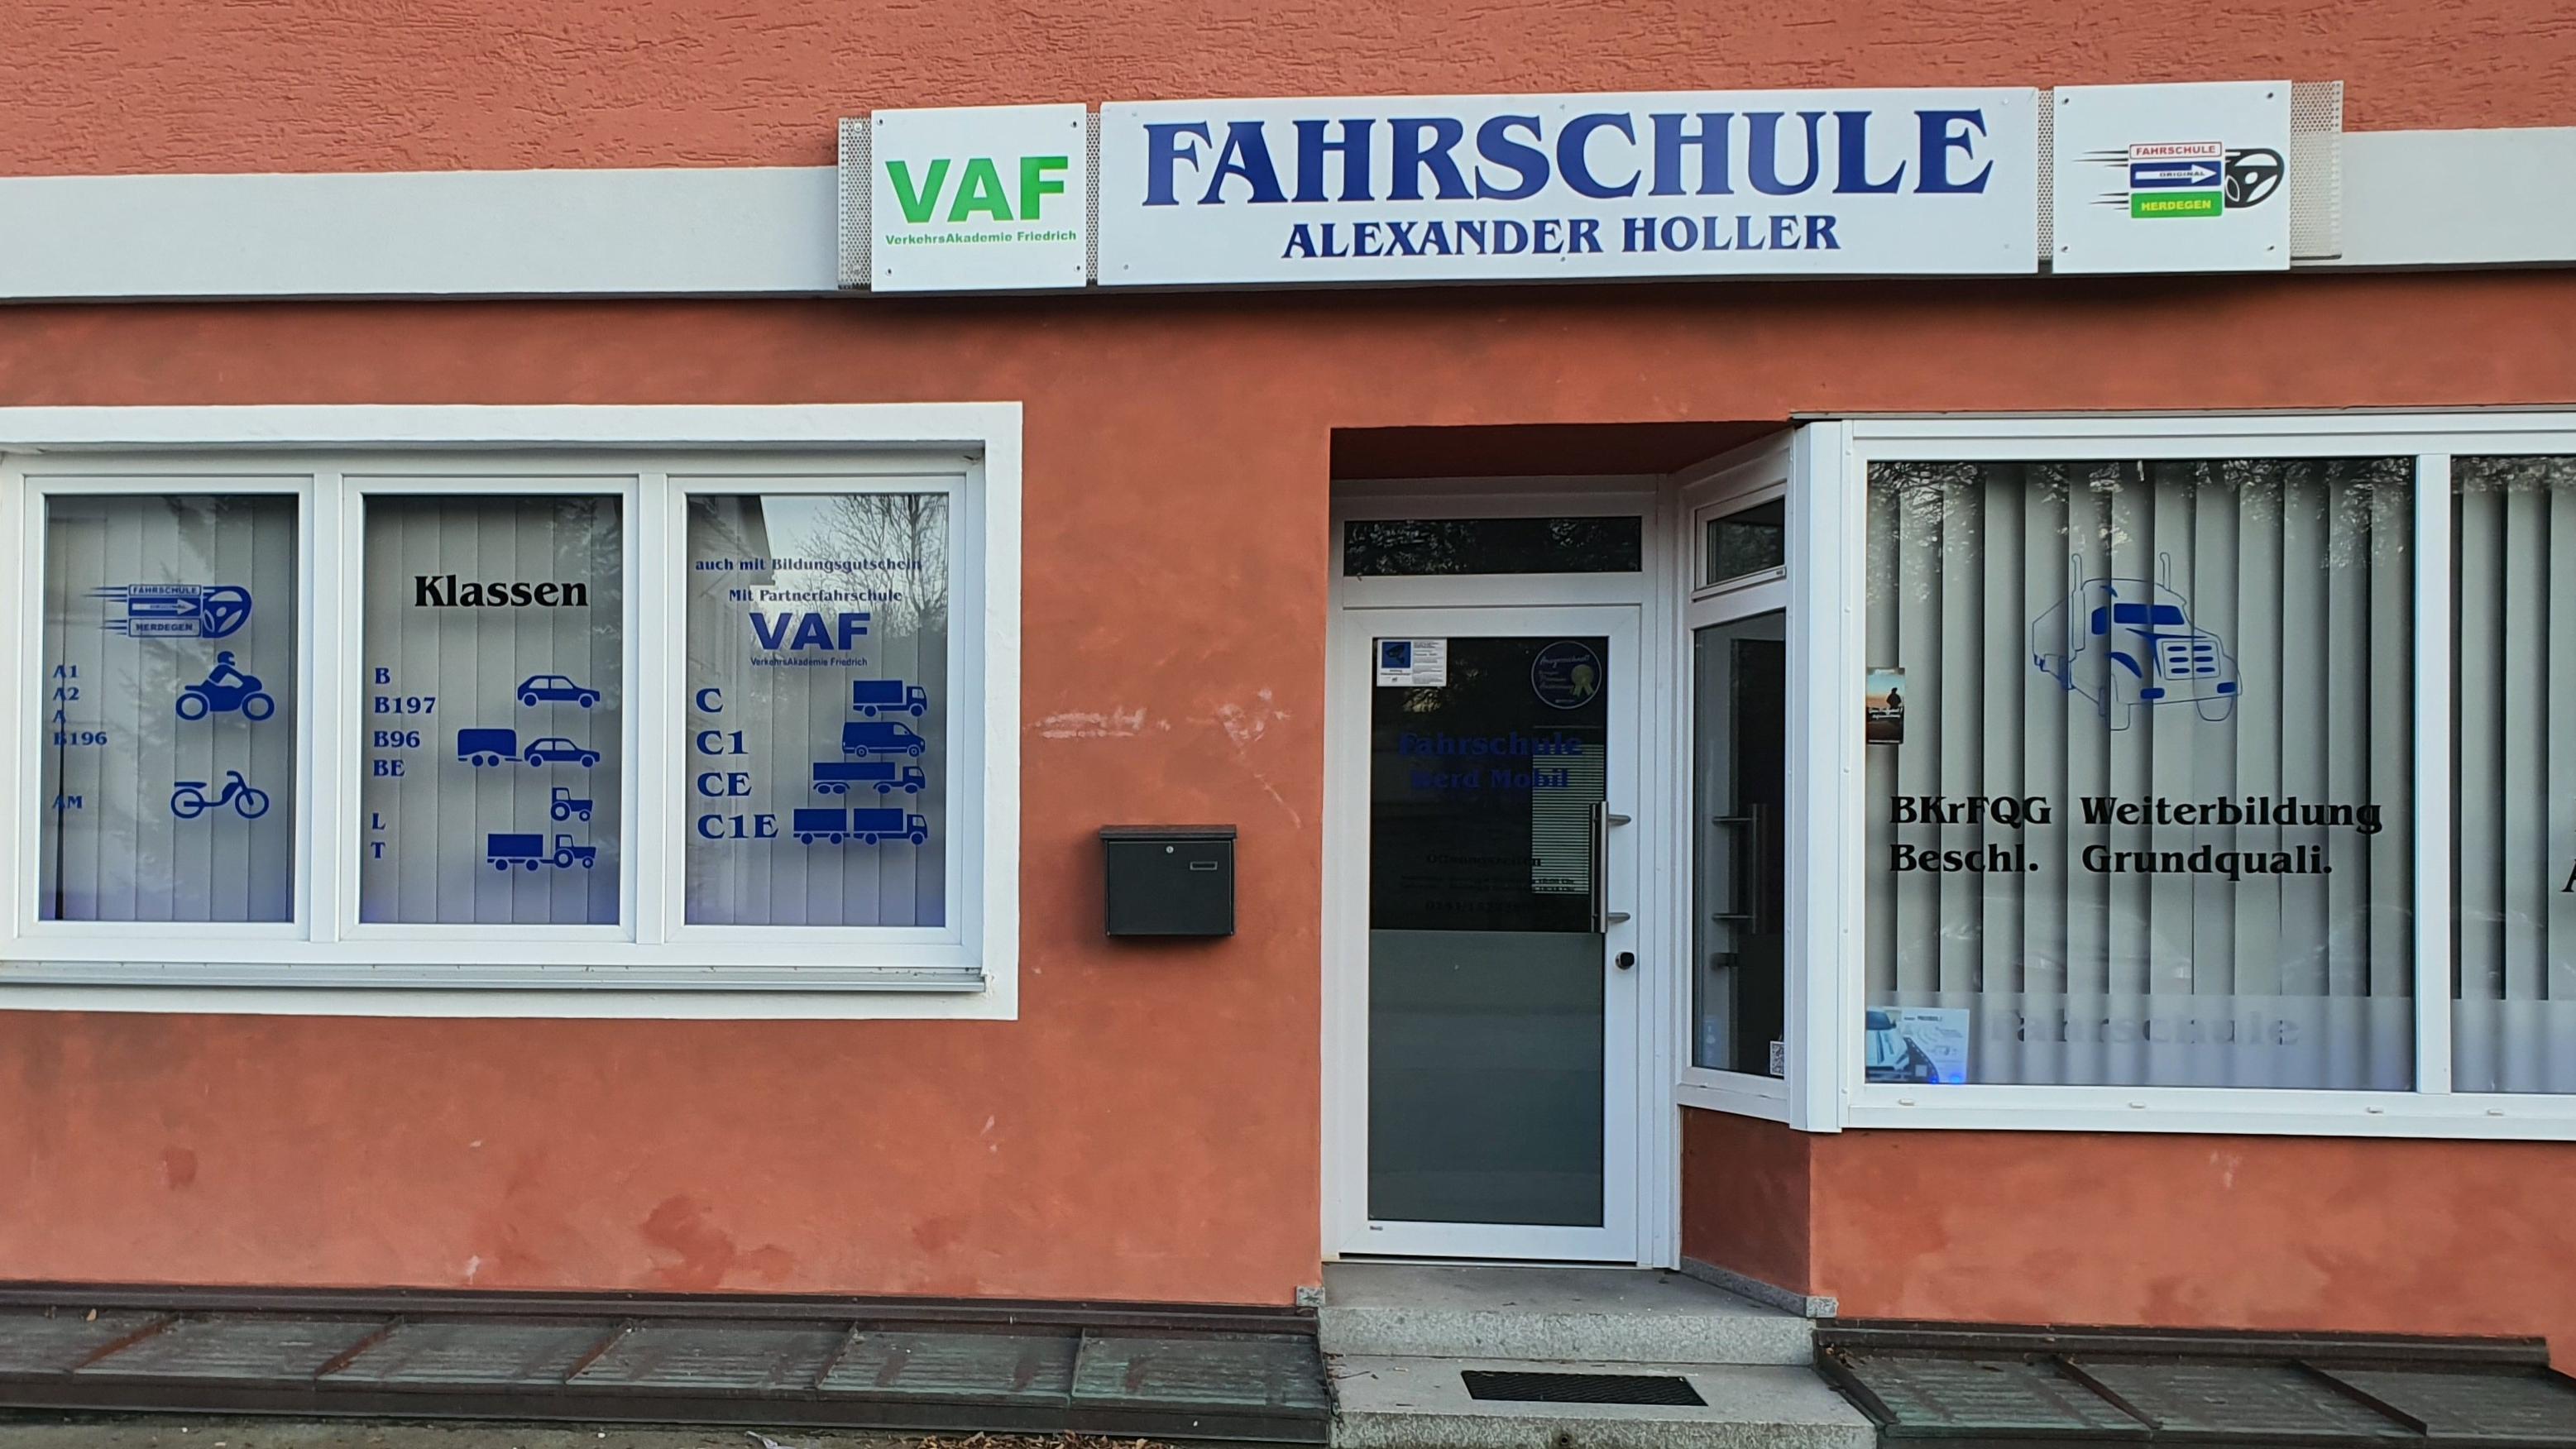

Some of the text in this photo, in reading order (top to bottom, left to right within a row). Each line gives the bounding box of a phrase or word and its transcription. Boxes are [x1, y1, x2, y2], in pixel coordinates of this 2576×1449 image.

[1142, 108, 1994, 207] FAHRSCHULE
[2136, 144, 2216, 156] FAHRSCHULE
[885, 155, 1070, 223] VAF
[2141, 199, 2211, 212] HERDEGEN
[885, 229, 1078, 246] VerkehrsAkademie Friedrich
[1281, 213, 1841, 260] ALEXANDER HOLLER
[695, 557, 922, 574] auch mit Bildungsgutschein
[133, 586, 198, 596] FAHRSCHULE
[414, 574, 589, 608] Klassen
[729, 588, 903, 602] Mit Partnerfahrschule
[136, 623, 194, 631] HERDEGEN
[749, 612, 871, 650] VAF
[750, 657, 869, 667] VerkehrsAkademie Friedrich
[52, 665, 79, 679] A1
[374, 667, 391, 685] B
[52, 687, 80, 702] A2
[695, 687, 724, 714] C
[374, 696, 437, 715] B197
[52, 709, 67, 724] A
[52, 731, 108, 747] B196
[373, 729, 422, 749] B96
[696, 729, 749, 756] C1
[1399, 730, 1583, 755] Fahrschule
[372, 759, 405, 777] BE
[697, 772, 753, 797] CE
[52, 794, 83, 810] AM
[371, 812, 386, 830] L
[1889, 796, 2382, 834] BKrFQG Weiterbildung
[697, 813, 779, 840] C1E
[371, 841, 386, 859] T
[1889, 843, 2334, 882] Beschl. Grundquali.
